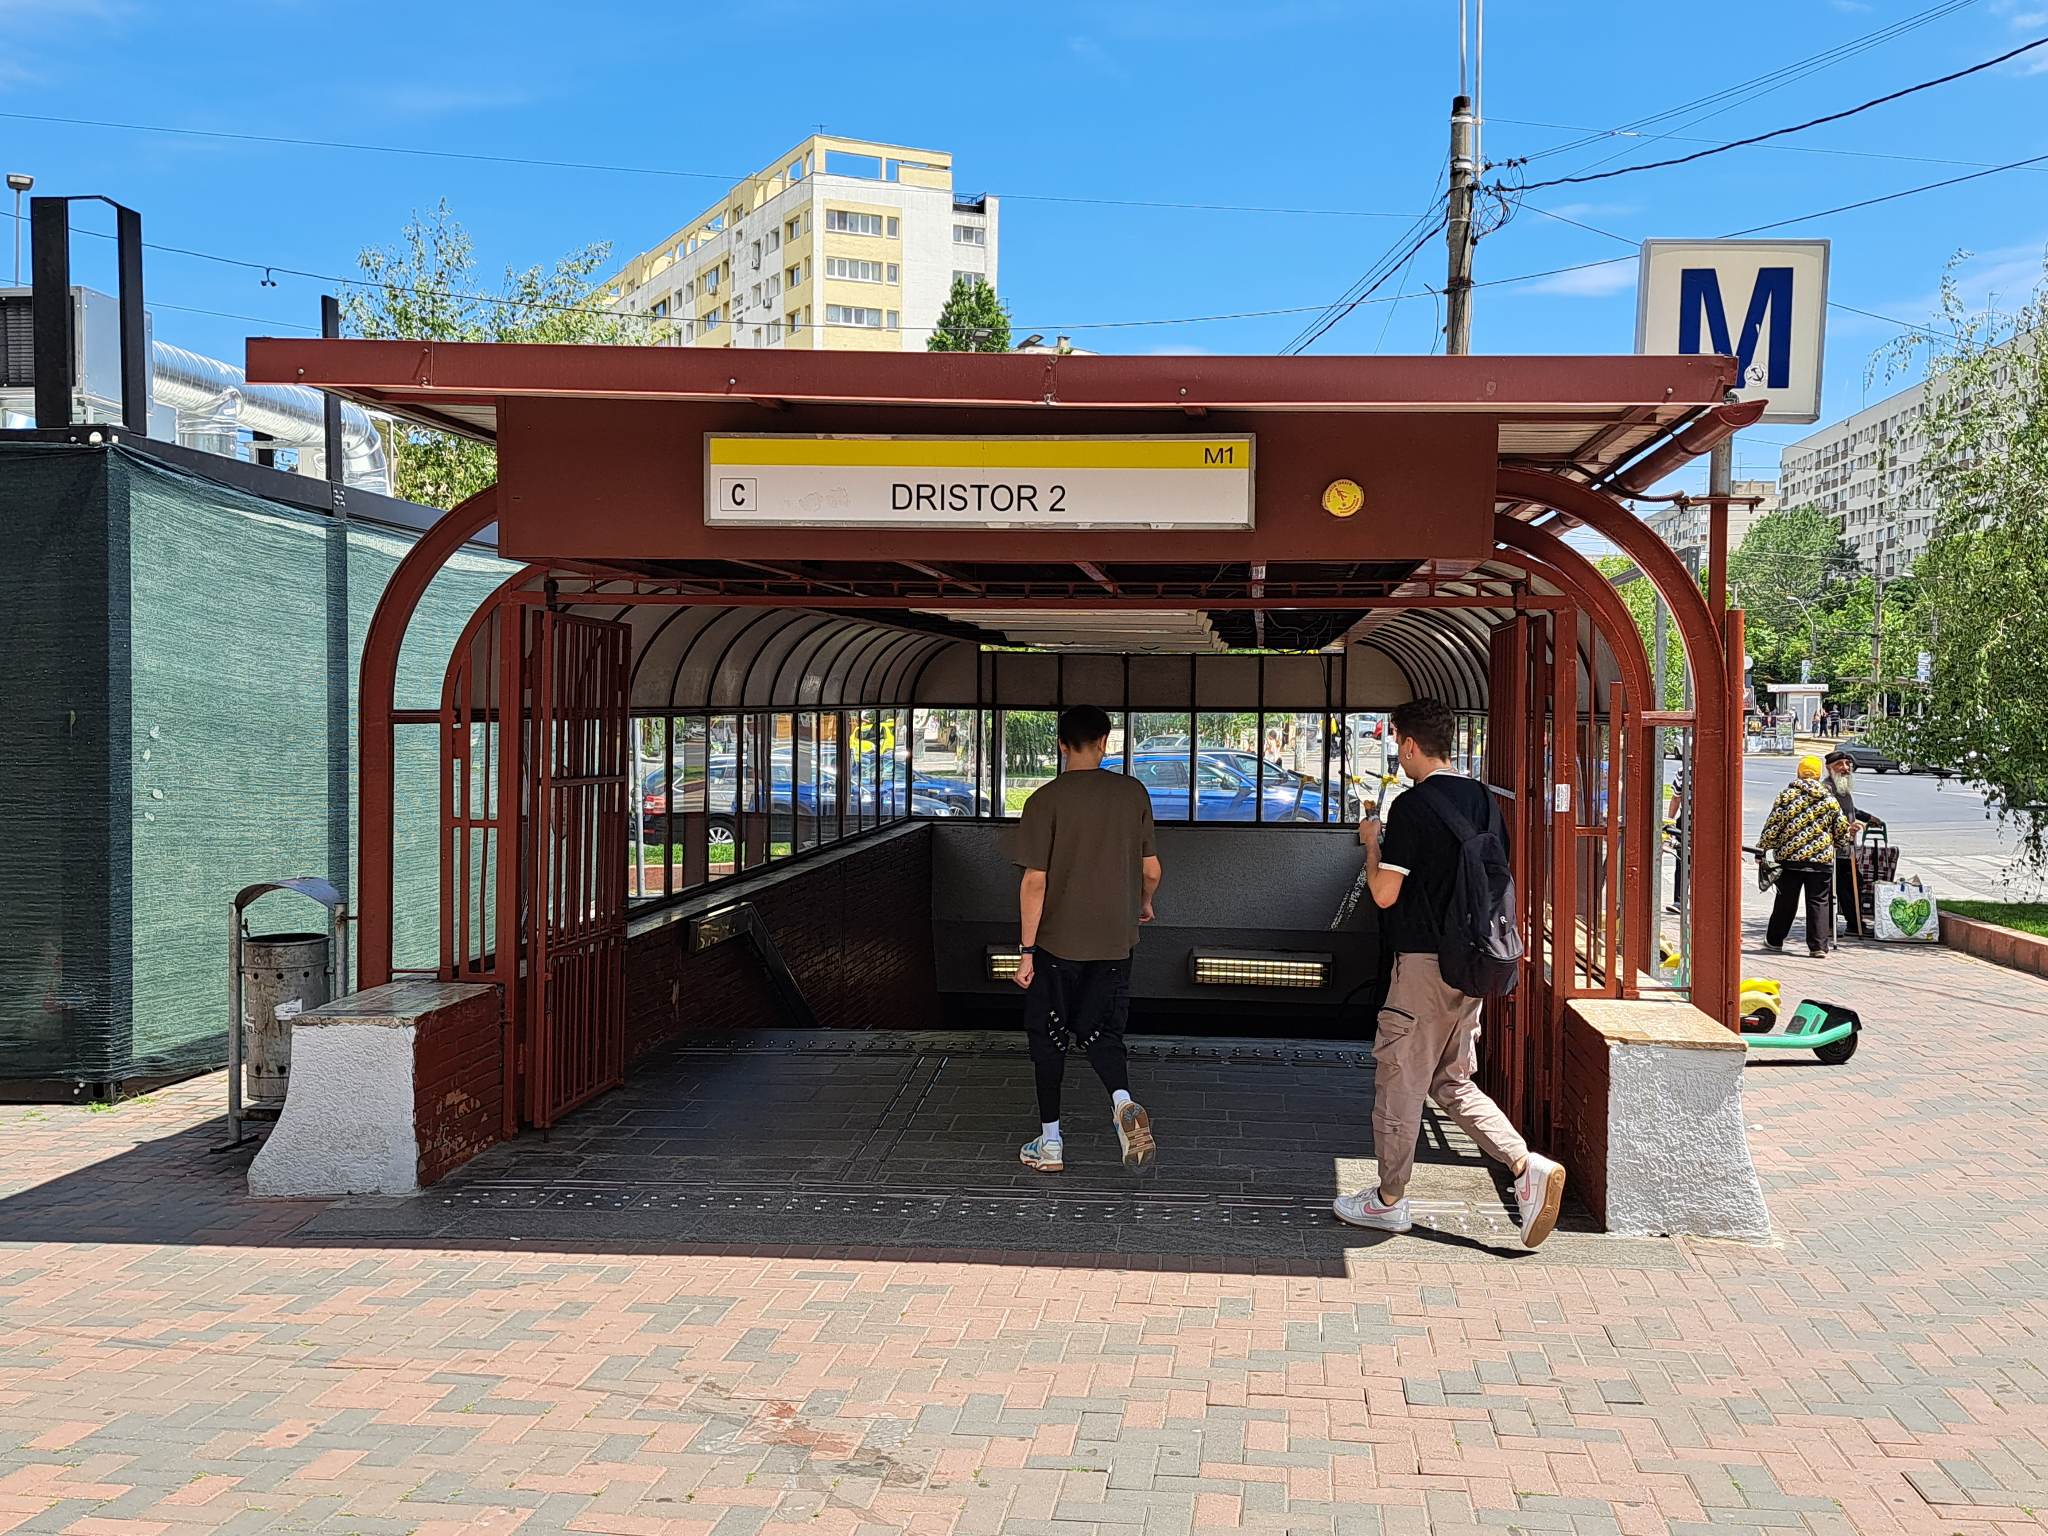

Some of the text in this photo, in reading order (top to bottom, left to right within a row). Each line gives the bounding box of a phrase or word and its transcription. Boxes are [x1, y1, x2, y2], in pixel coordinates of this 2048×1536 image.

[1678, 267, 1794, 389] M
[1204, 446, 1234, 466] M1
[731, 483, 746, 506] C
[891, 483, 1067, 512] DRISTOR 2
